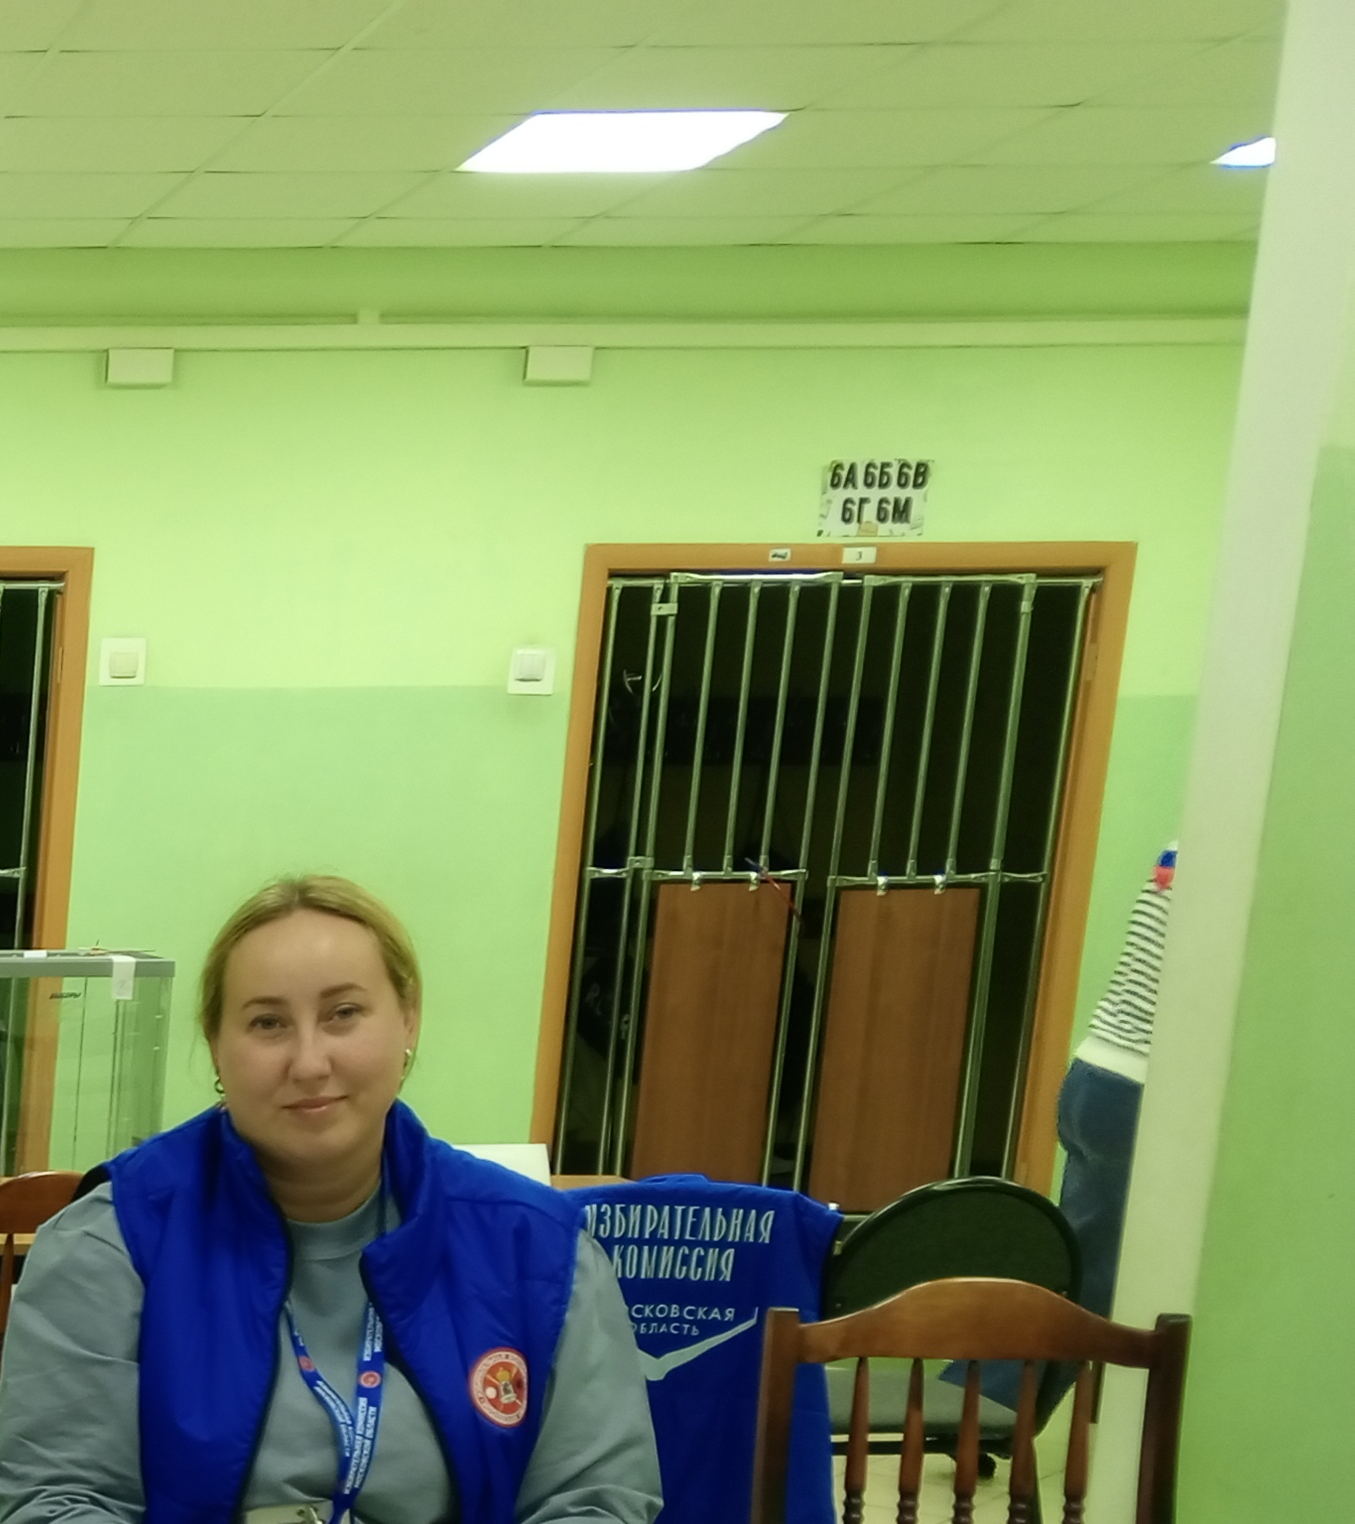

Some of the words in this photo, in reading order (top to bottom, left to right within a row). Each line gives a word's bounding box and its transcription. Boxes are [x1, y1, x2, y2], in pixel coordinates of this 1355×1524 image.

[830, 462, 858, 490] 6А
[863, 462, 893, 490] 6Б
[897, 462, 929, 490] 6В
[841, 497, 871, 525] 6Г
[876, 497, 913, 525] 6М
[585, 1203, 775, 1244] ИЗБИРАТЕЛЬНАЯ
[612, 1244, 735, 1281] КОМИССИЯ
[631, 1304, 735, 1322] СКОВСКАЯ
